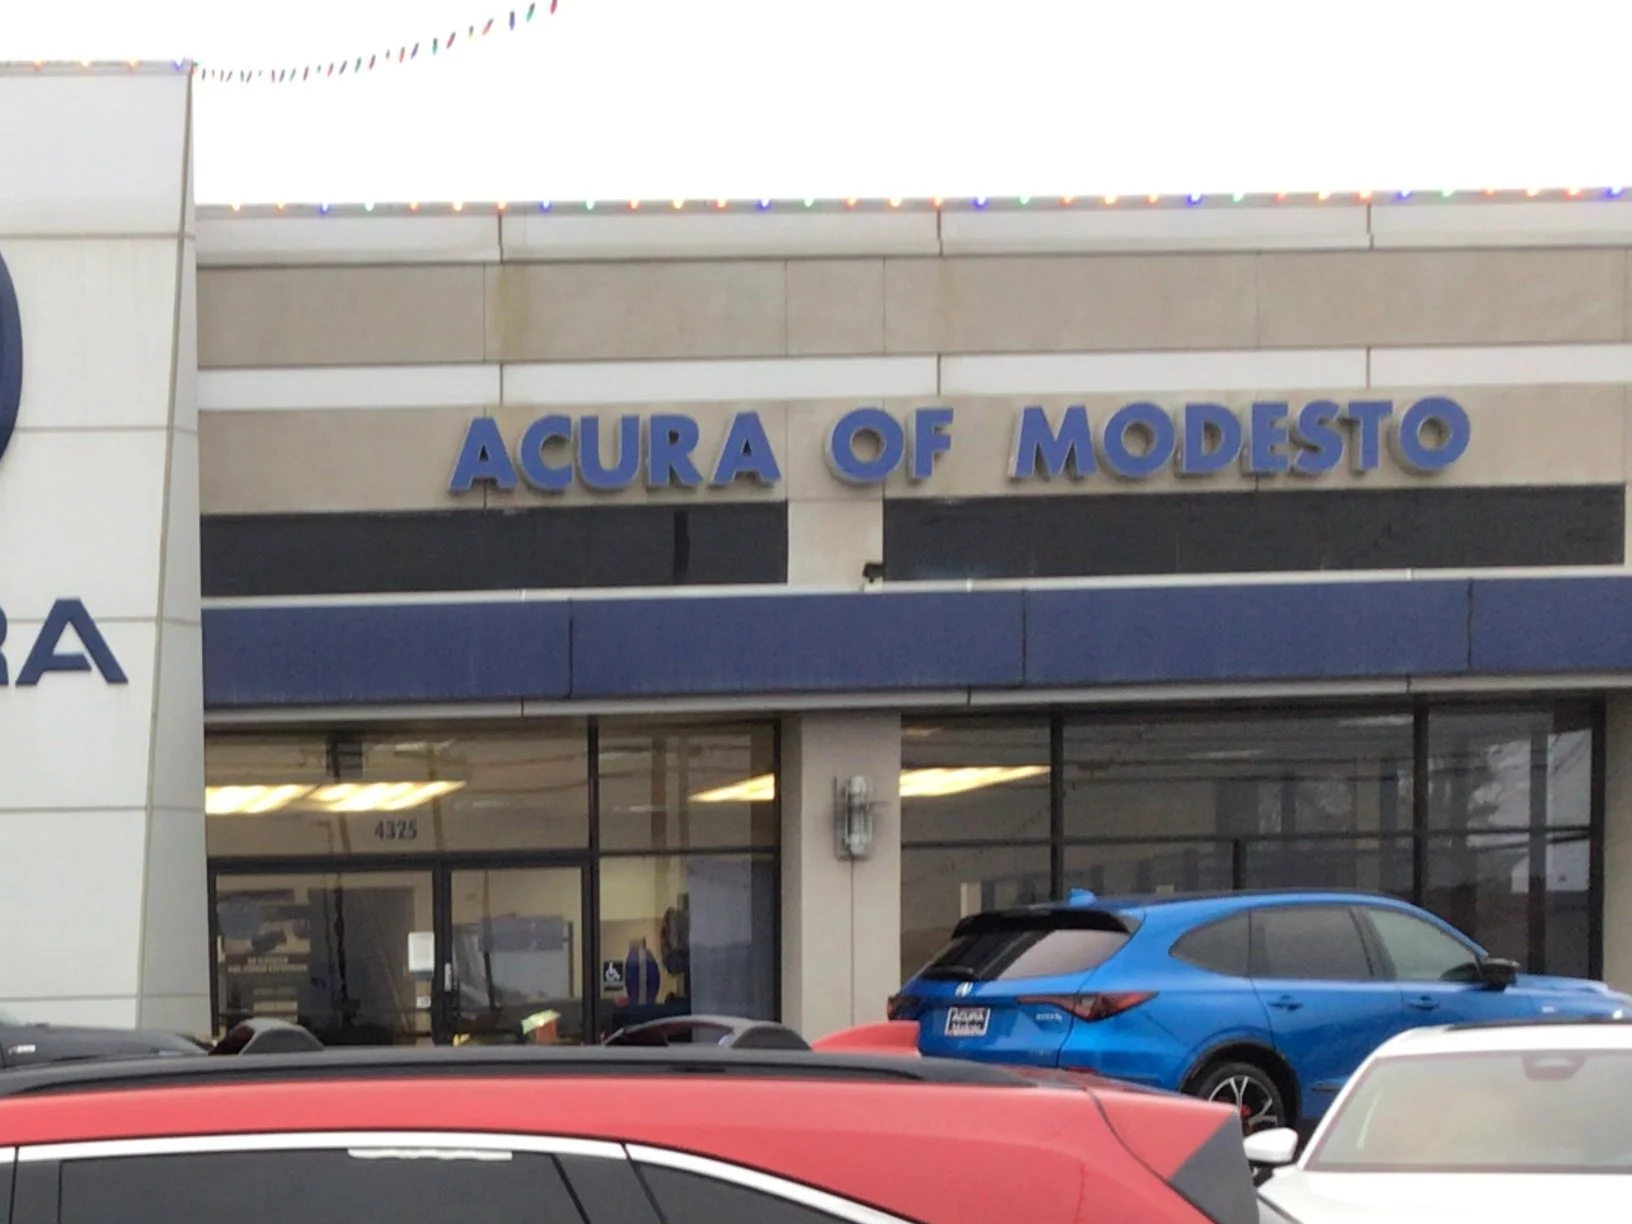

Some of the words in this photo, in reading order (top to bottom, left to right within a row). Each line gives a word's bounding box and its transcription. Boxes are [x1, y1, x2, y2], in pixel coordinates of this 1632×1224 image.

[447, 410, 782, 495] ACURA
[825, 407, 954, 486] OF
[1007, 395, 1472, 481] MODESTO
[375, 820, 418, 839] 4325
